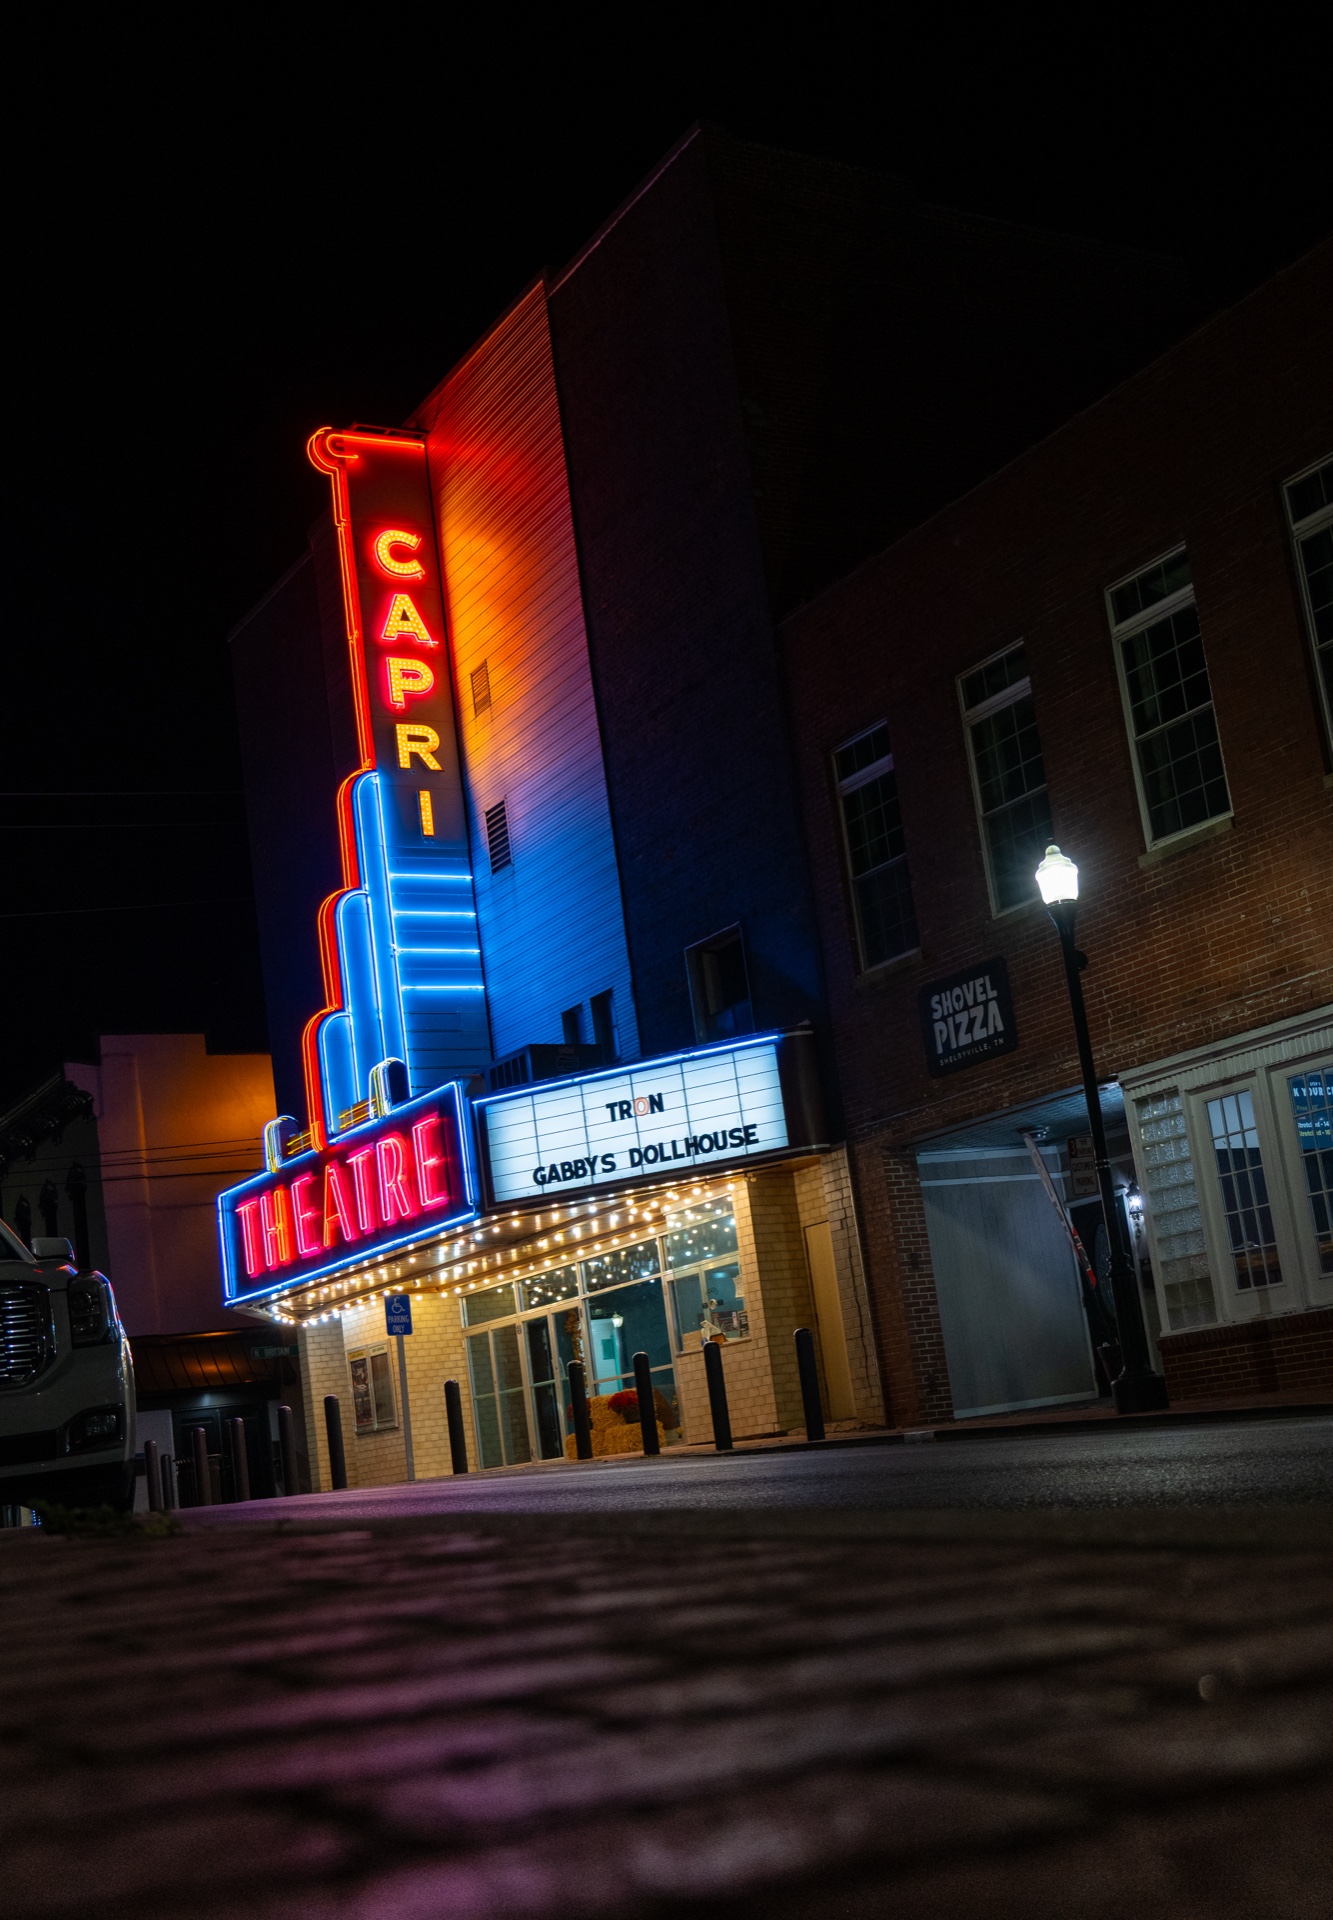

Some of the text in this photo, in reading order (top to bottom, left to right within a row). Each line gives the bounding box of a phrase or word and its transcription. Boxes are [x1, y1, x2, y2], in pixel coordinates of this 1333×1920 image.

[375, 529, 443, 837] CAPRI
[930, 975, 998, 1020] SHOVEL
[933, 1000, 1005, 1055] PIZZA
[993, 1037, 1005, 1046] TN
[606, 1092, 665, 1122] TRON
[1301, 1086, 1324, 1097] YOUR
[629, 1124, 759, 1168] DOLLHOUSE
[235, 1112, 449, 1278] THEATRE
[388, 1315, 410, 1324] PARKING
[392, 1325, 405, 1334] ONLY
